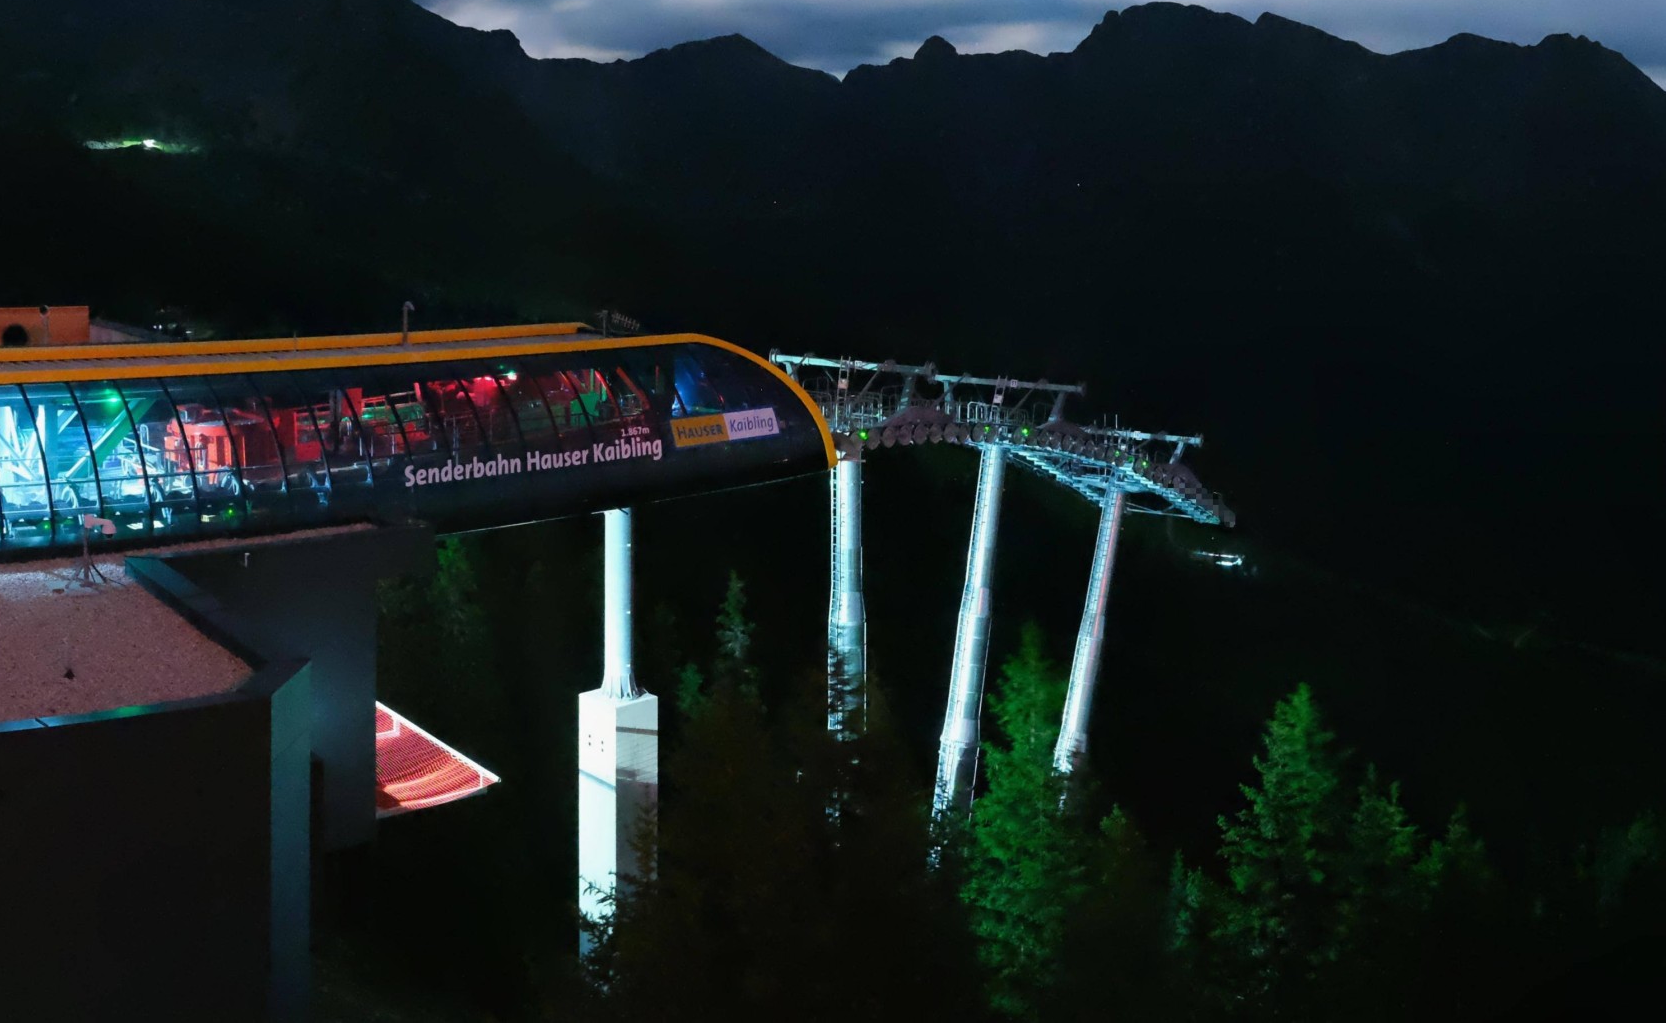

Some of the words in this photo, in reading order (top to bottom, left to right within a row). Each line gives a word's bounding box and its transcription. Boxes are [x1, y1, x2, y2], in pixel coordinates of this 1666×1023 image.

[677, 424, 725, 440] HAUSER
[729, 417, 773, 433] Kaibling
[404, 453, 522, 488] Senderbahn
[526, 448, 590, 472] Hauser
[593, 437, 663, 463] Kaibling
